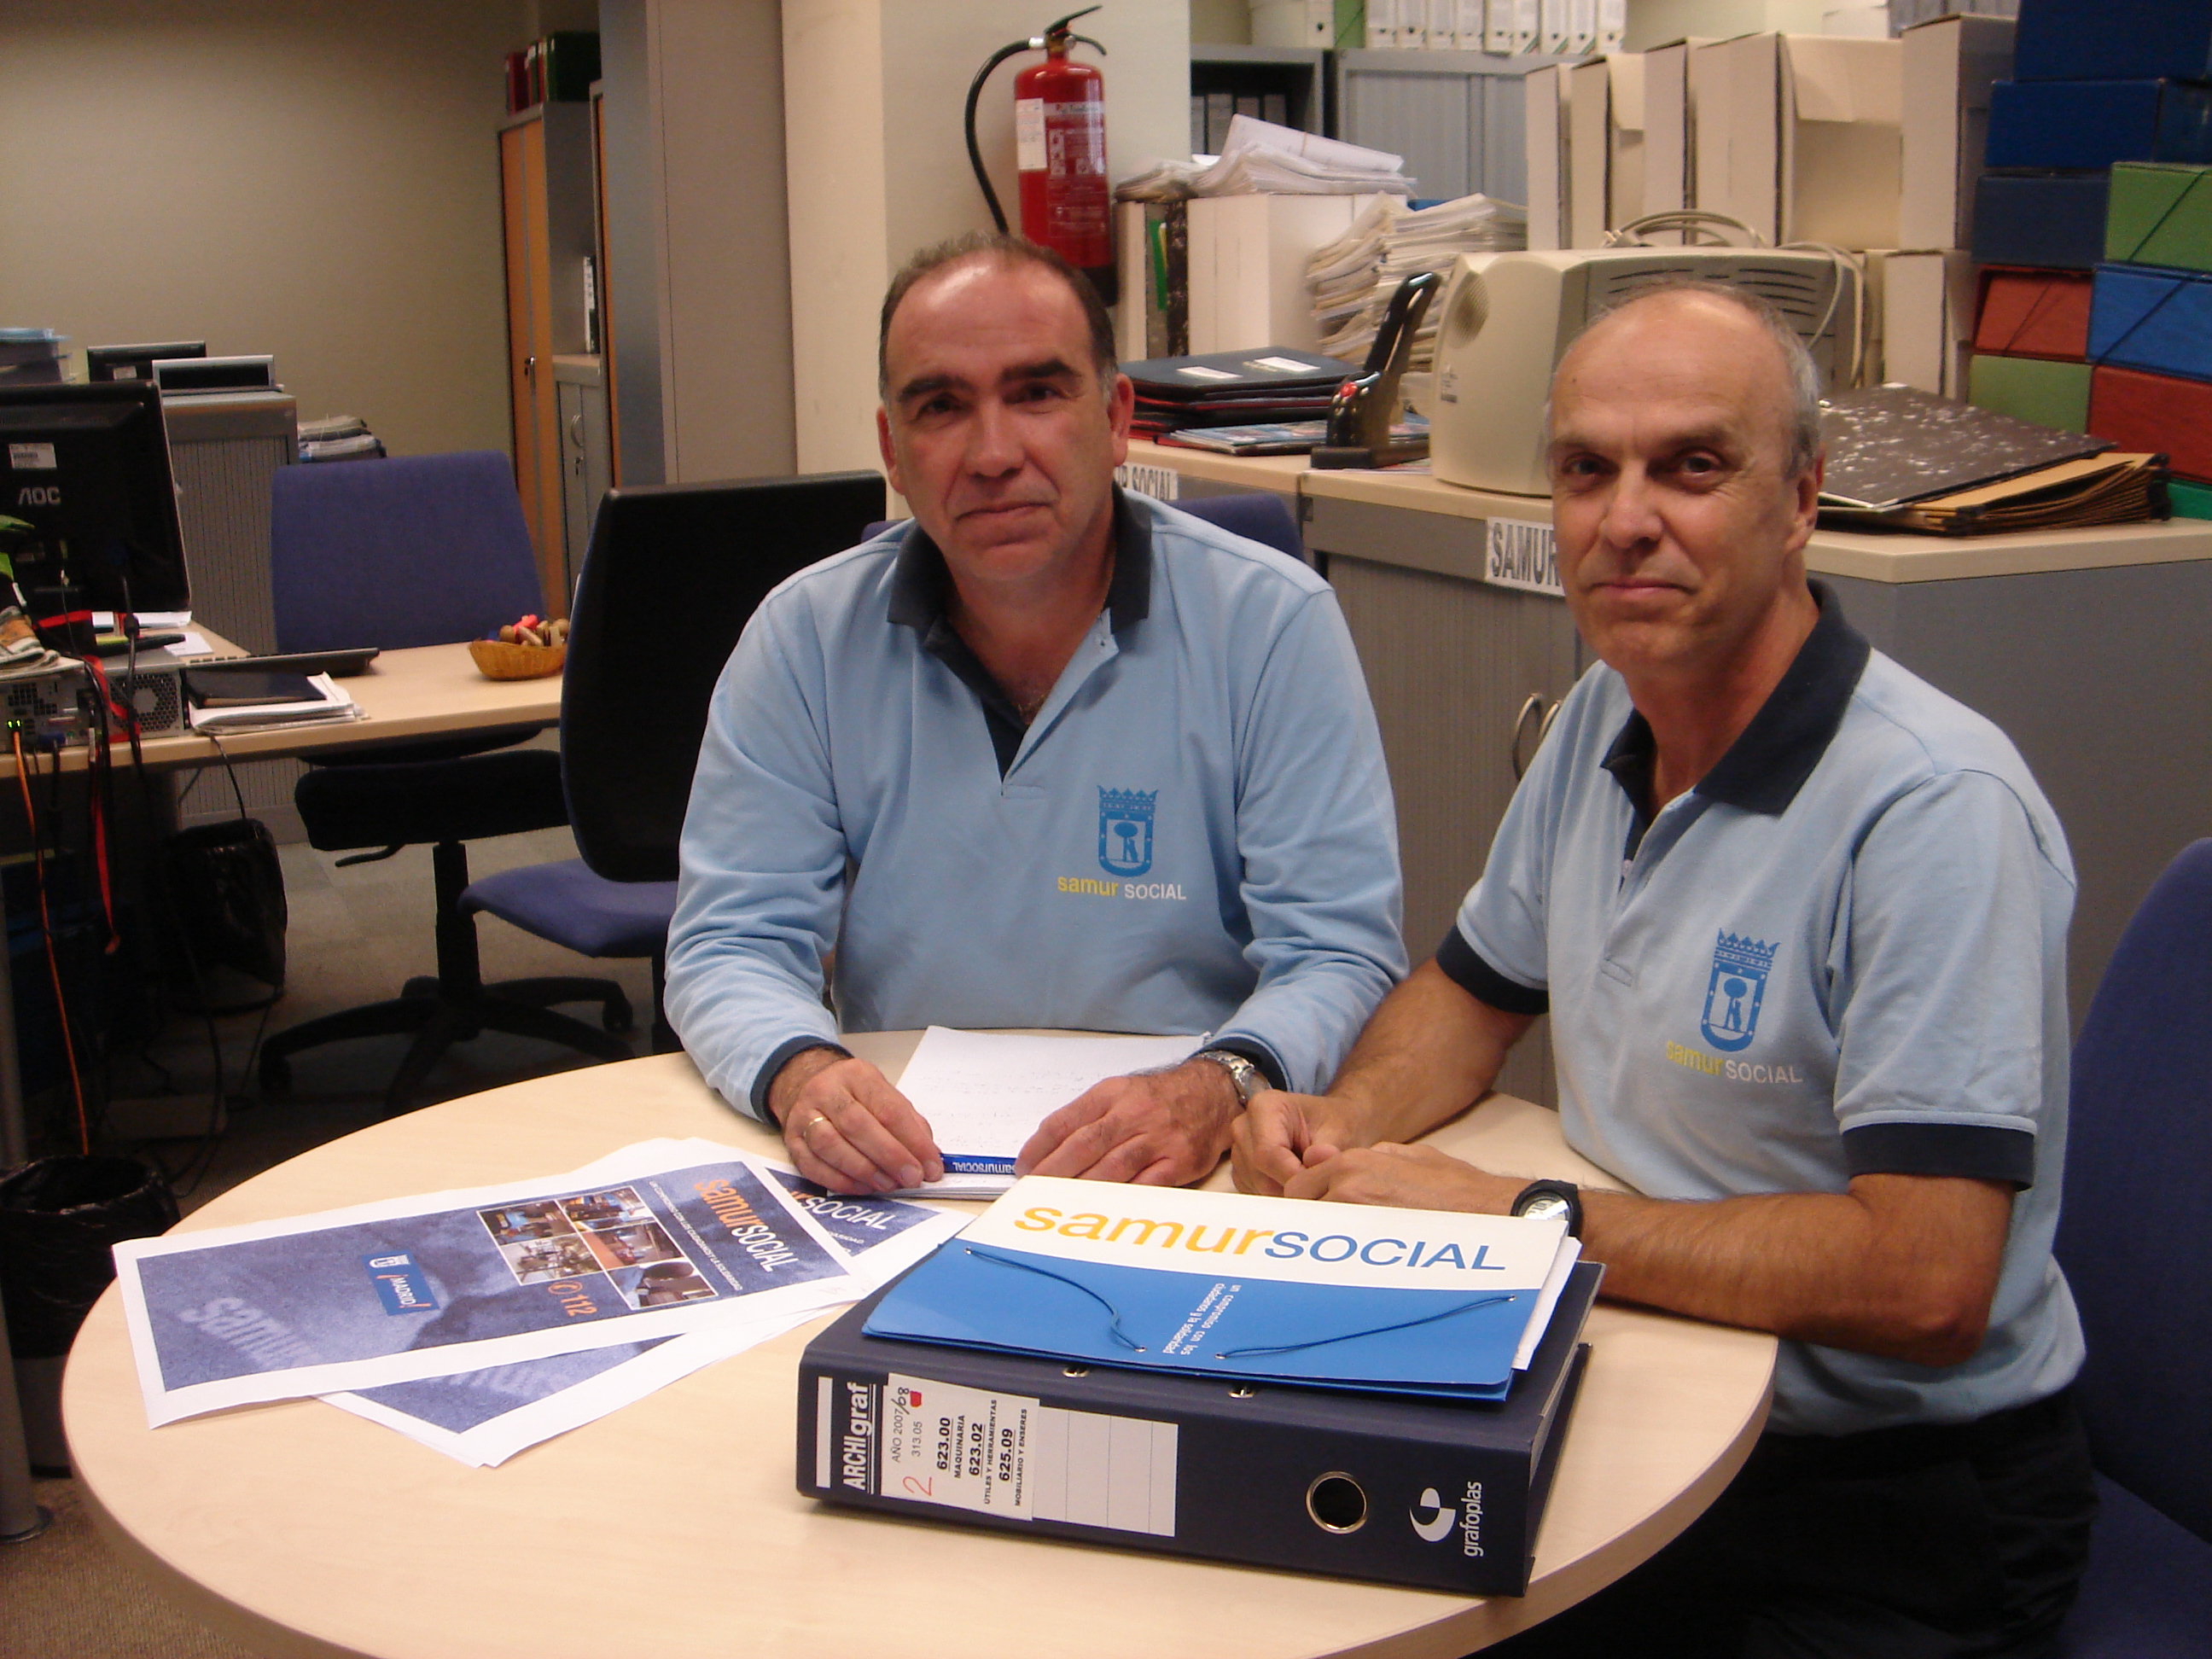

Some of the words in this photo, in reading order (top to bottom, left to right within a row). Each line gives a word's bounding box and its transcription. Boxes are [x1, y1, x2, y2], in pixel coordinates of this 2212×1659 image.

[18, 486, 61, 505] AOC
[1057, 876, 1119, 896] samur
[1124, 883, 1187, 900] SOCIAL
[1666, 1039, 1724, 1076] samur
[1725, 1059, 1803, 1084] SOCIAL
[560, 1294, 597, 1317] 112
[891, 1435, 903, 1464] AÑO
[911, 1420, 923, 1458] 313.05
[936, 1417, 952, 1470] 623.00
[953, 1414, 966, 1479] MAQUINARIA
[969, 1423, 983, 1476] 623.02
[986, 1399, 998, 1466] HERRAMIENTAS
[1018, 1408, 1027, 1448] ENSERES
[998, 1428, 1014, 1482] 625.09
[902, 1476, 933, 1497] 2
[1014, 1458, 1025, 1507] MOBILIARIO
[1458, 1481, 1484, 1557] grafoplas
